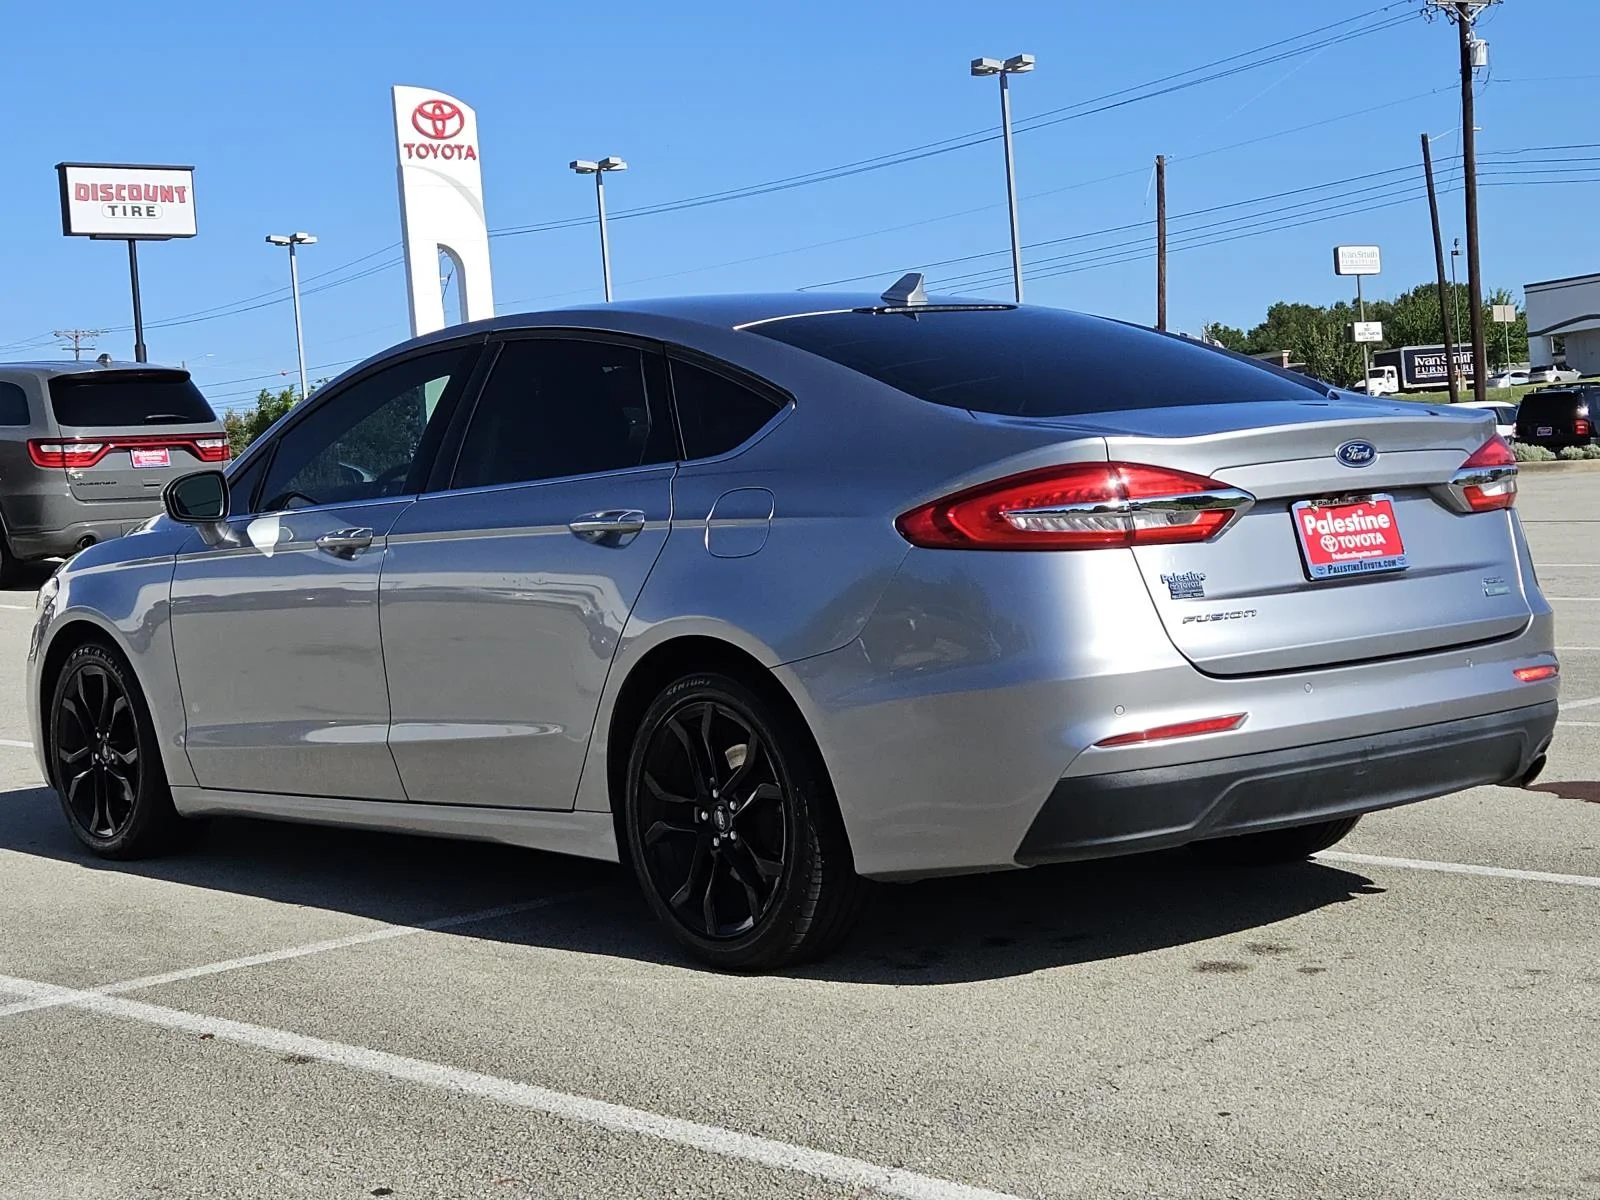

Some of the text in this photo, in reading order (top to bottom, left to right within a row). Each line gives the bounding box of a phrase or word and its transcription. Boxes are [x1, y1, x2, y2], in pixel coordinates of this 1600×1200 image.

[403, 143, 477, 160] TOYOTA
[74, 183, 186, 203] DISCOUNT
[107, 205, 156, 217] TIRE
[1414, 355, 1440, 366] Ivan
[1346, 445, 1371, 460] Ford
[1303, 509, 1391, 536] Palestine
[1337, 532, 1387, 549] TOYOTA
[1160, 571, 1206, 585] Palestine
[1182, 609, 1257, 625] FUSION
